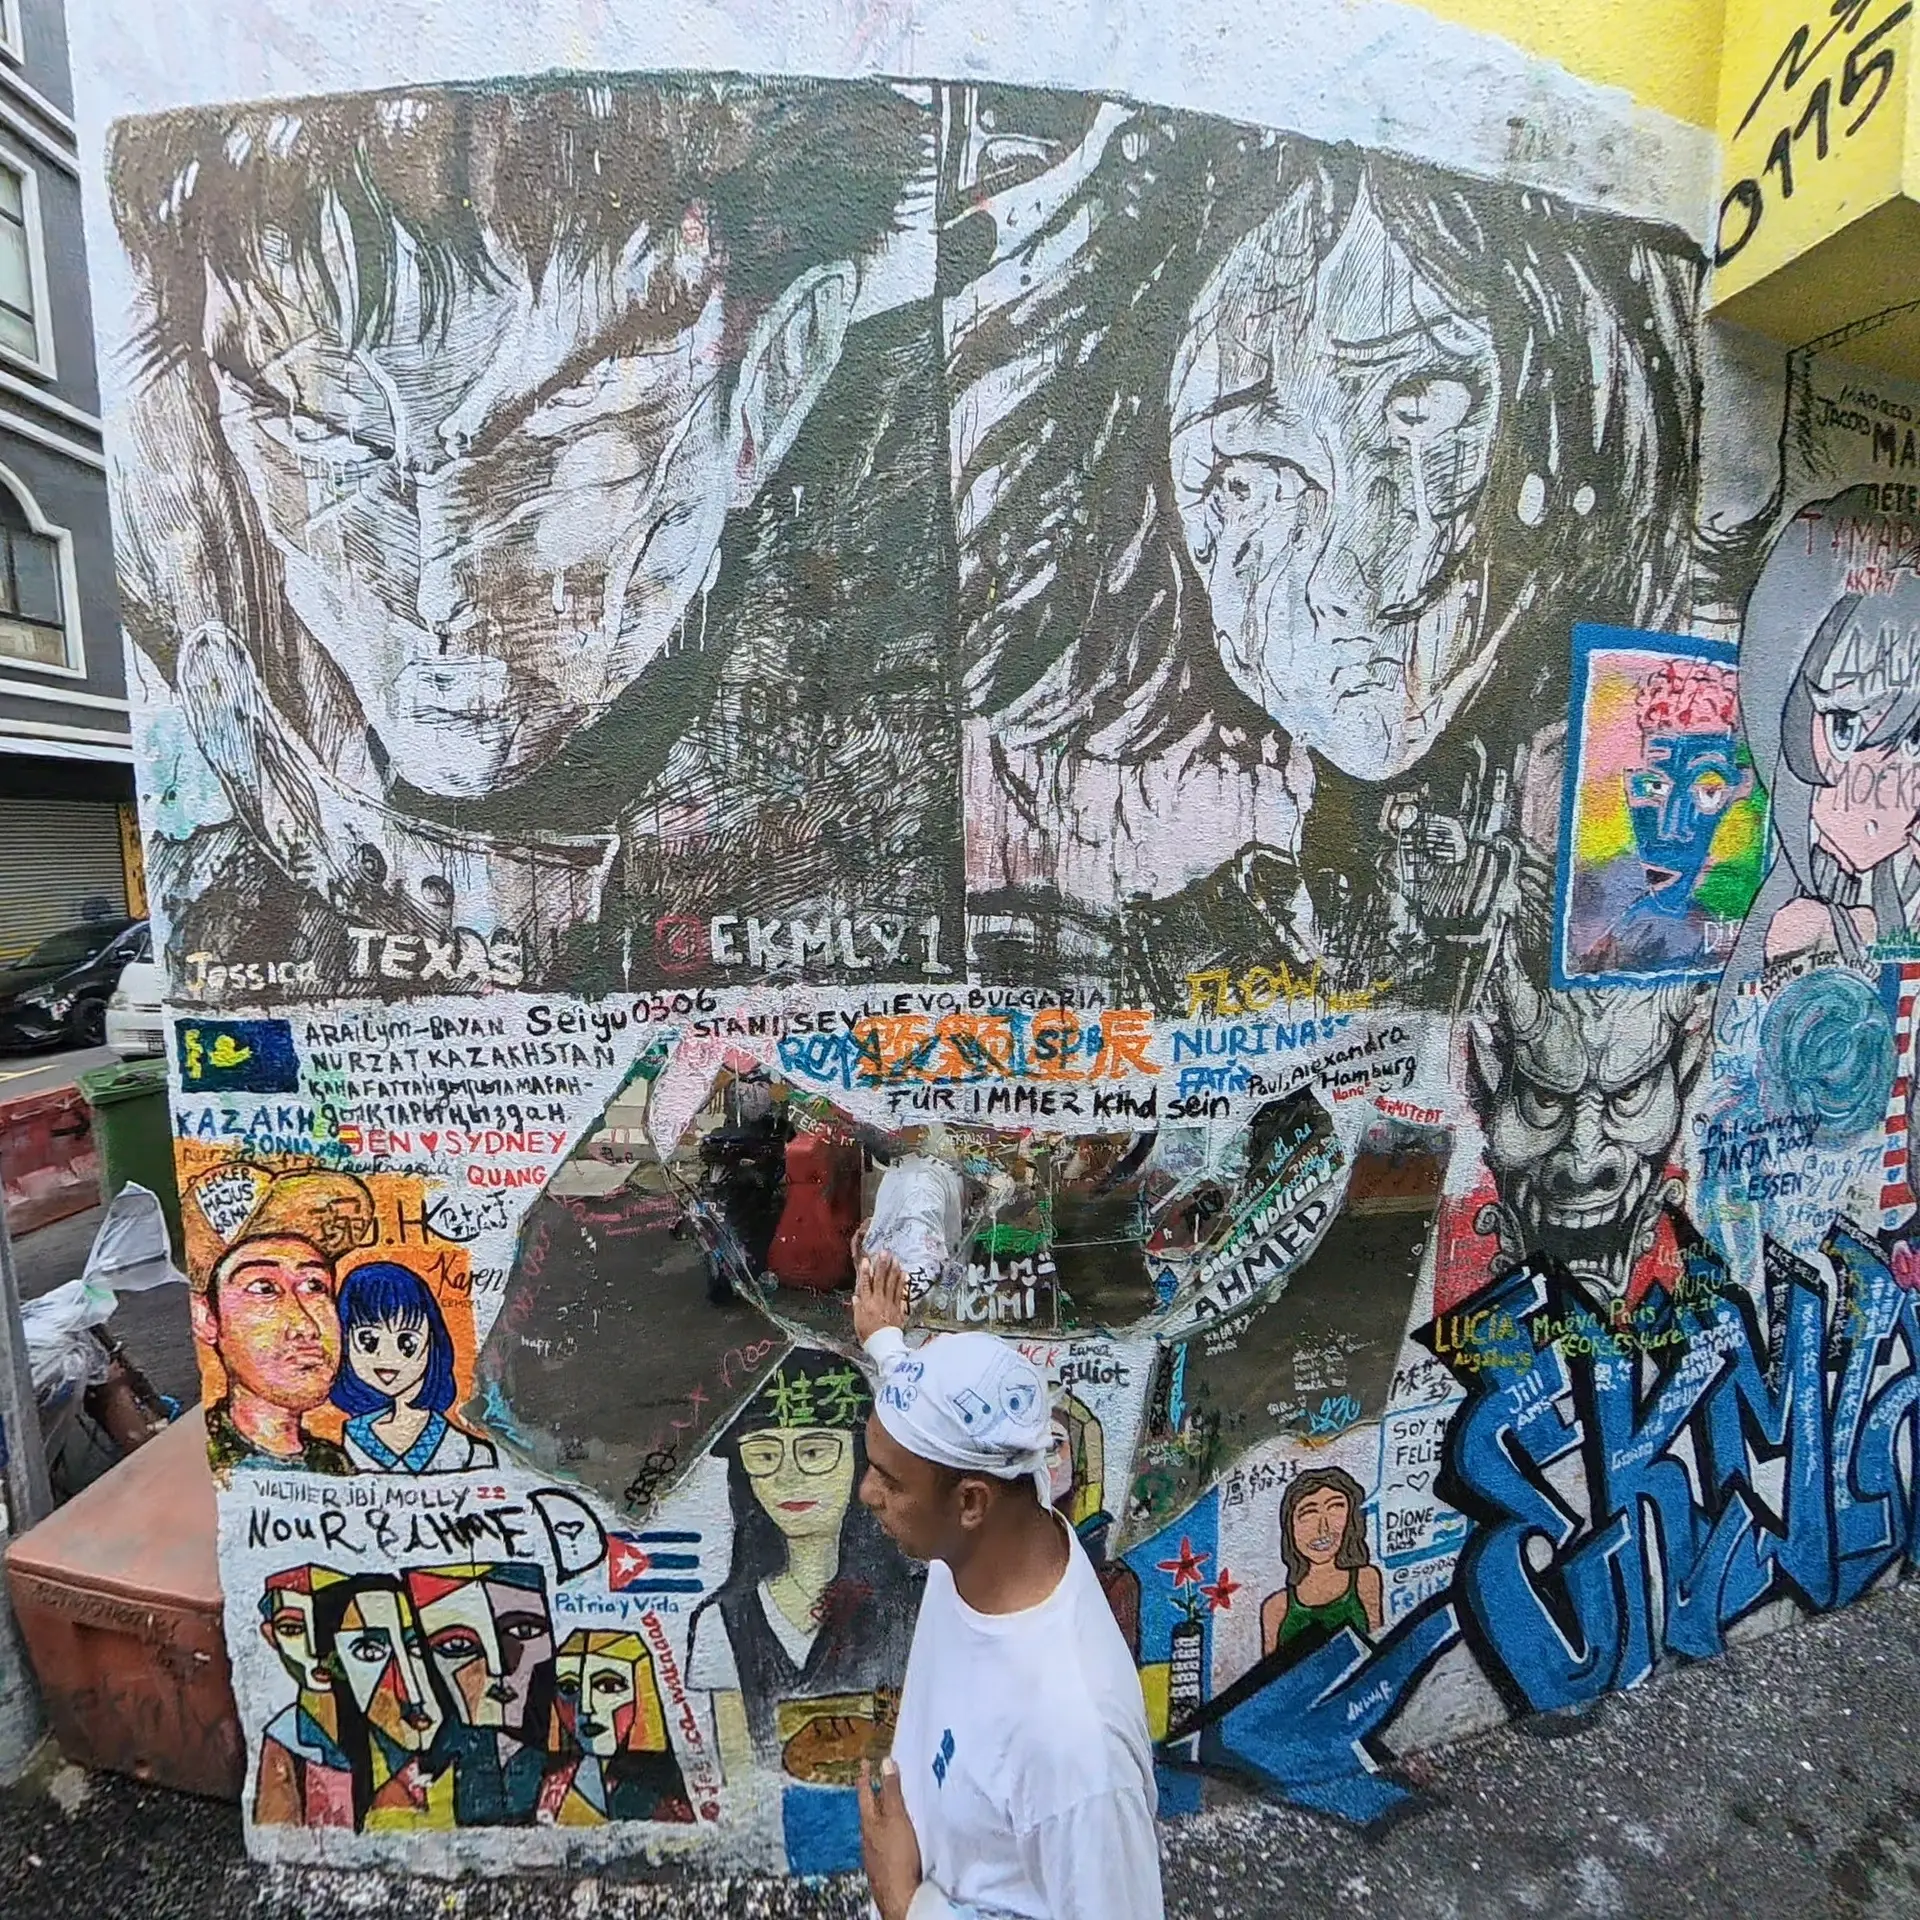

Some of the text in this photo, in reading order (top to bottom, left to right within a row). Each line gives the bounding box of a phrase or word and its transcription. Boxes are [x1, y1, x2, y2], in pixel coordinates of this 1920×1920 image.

[968, 987, 1106, 1010] BULGARIA
[1291, 1026, 1411, 1085] Alexandra
[1320, 1055, 1418, 1089] Hamburg
[887, 1087, 955, 1115] FÜR
[973, 1086, 1081, 1116] IMMER
[444, 1130, 566, 1156] SYDNEY
[467, 1164, 548, 1188] QUANG
[1748, 1171, 1802, 1202] ESSEN
[427, 1252, 502, 1298] Karen
[1186, 1199, 1328, 1324] AHMED
[1504, 1369, 1544, 1415] Jill
[1393, 1418, 1428, 1441] SOY
[633, 1595, 679, 1614] Vida
